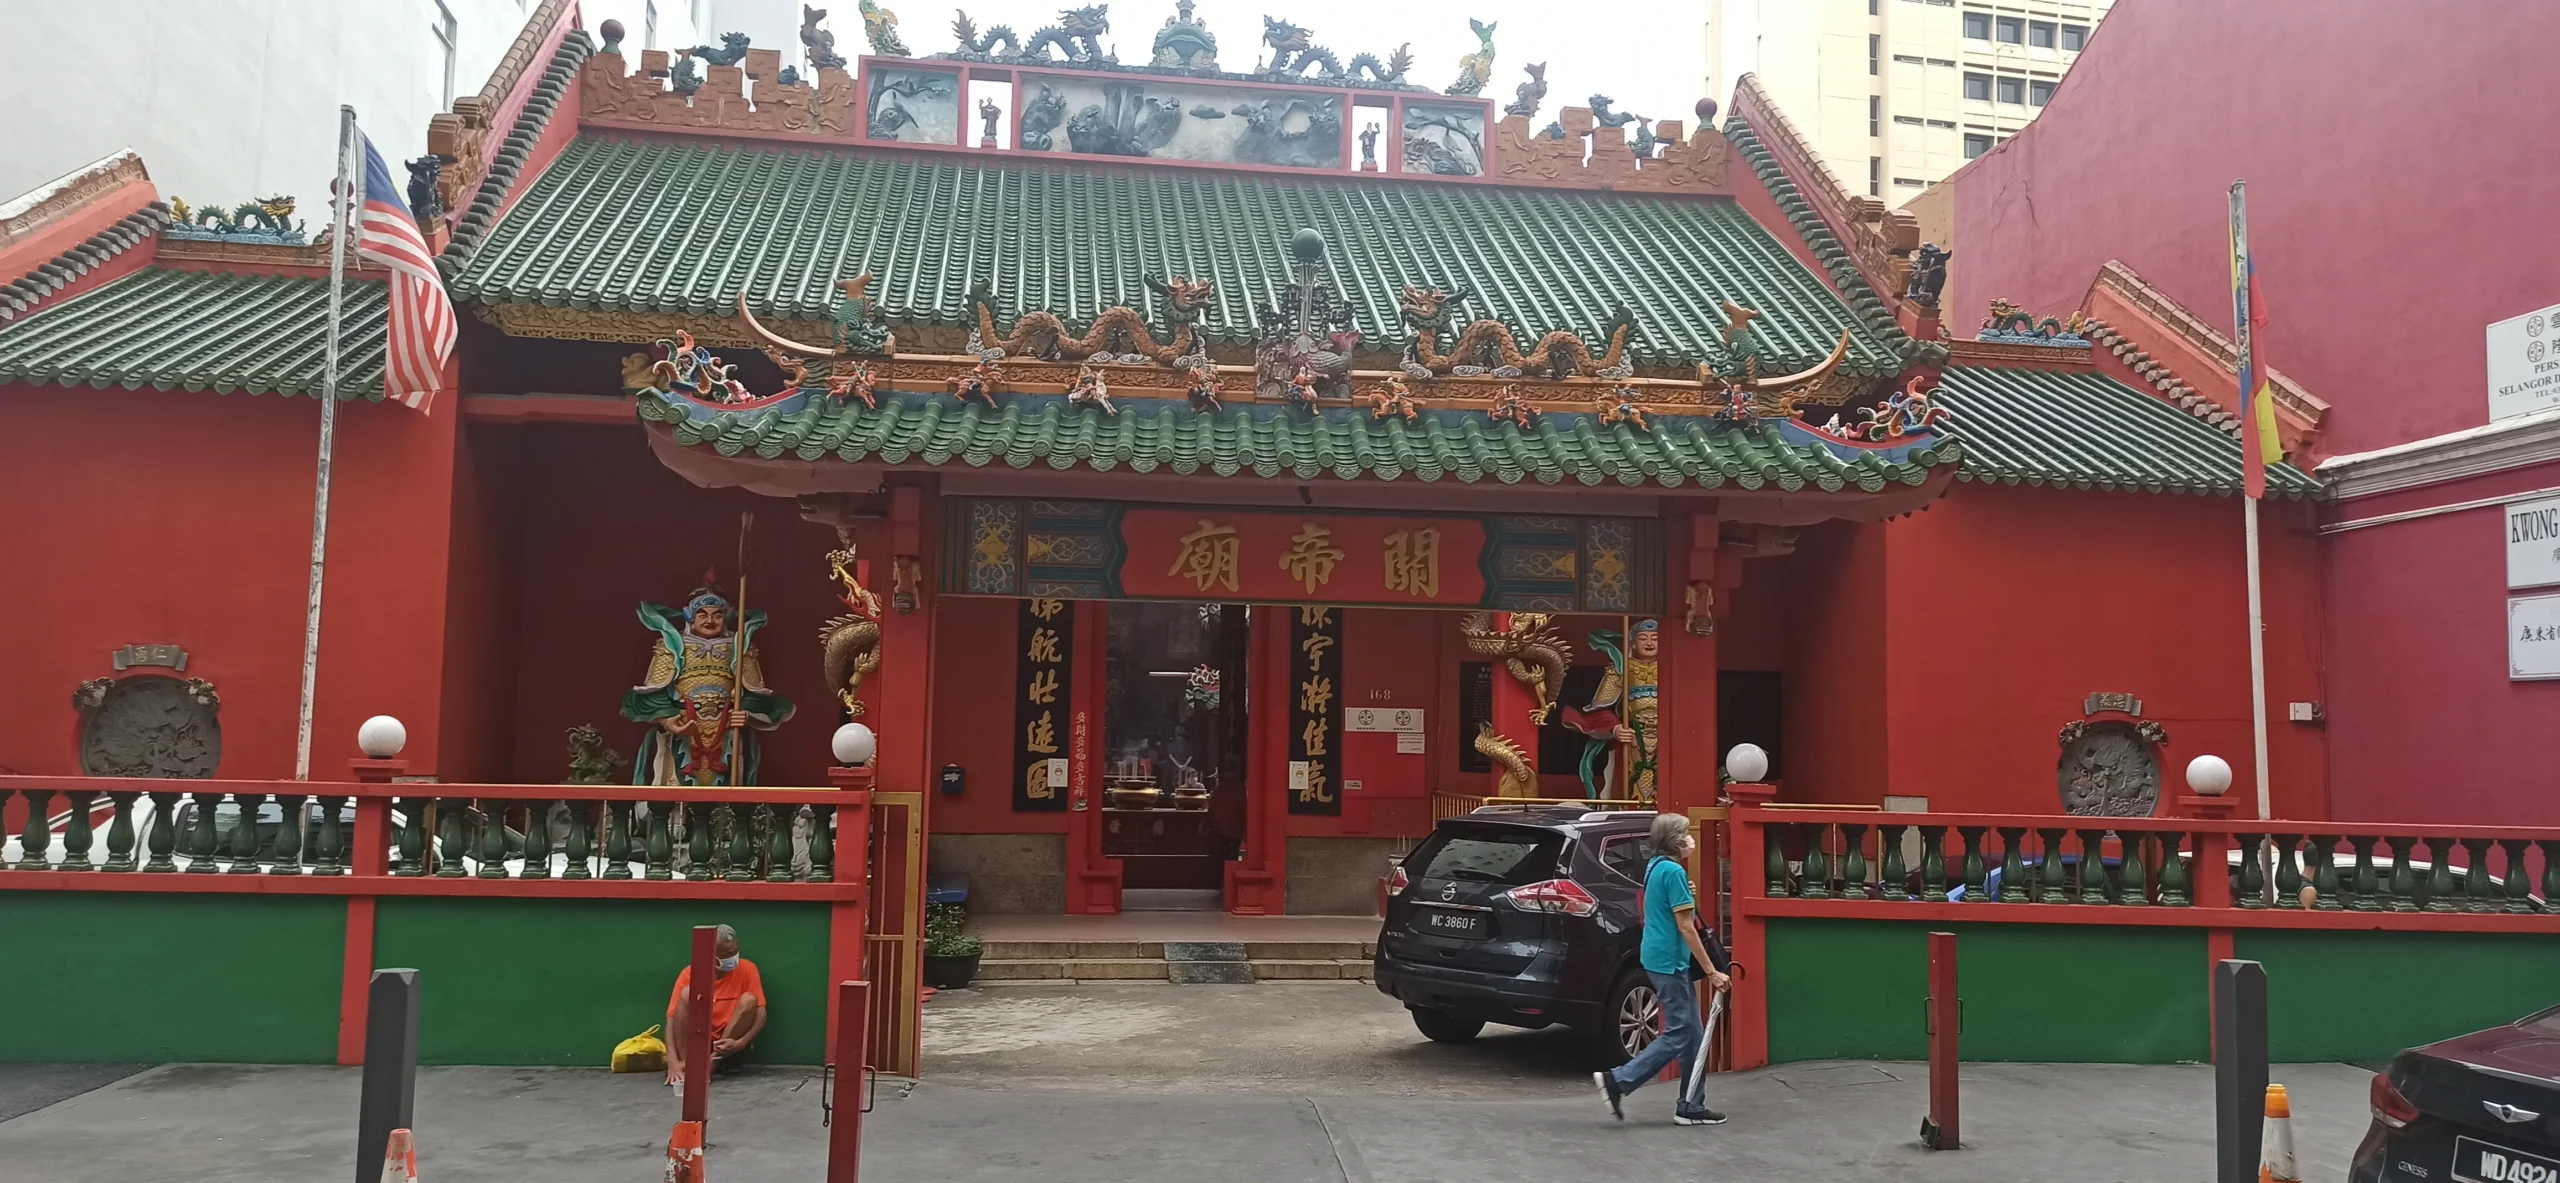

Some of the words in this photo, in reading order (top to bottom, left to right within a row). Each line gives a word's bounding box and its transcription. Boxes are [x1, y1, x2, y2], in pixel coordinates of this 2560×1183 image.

[2499, 376, 2552, 397] SELANGOR
[2511, 507, 2559, 544] KWONG
[2519, 624, 2560, 643] 廣東省
[1370, 688, 1391, 701] 168
[1431, 914, 1444, 926] WC
[1444, 915, 1468, 929] 3860
[1469, 918, 1477, 930] F
[2397, 1160, 2429, 1178] GENESIS
